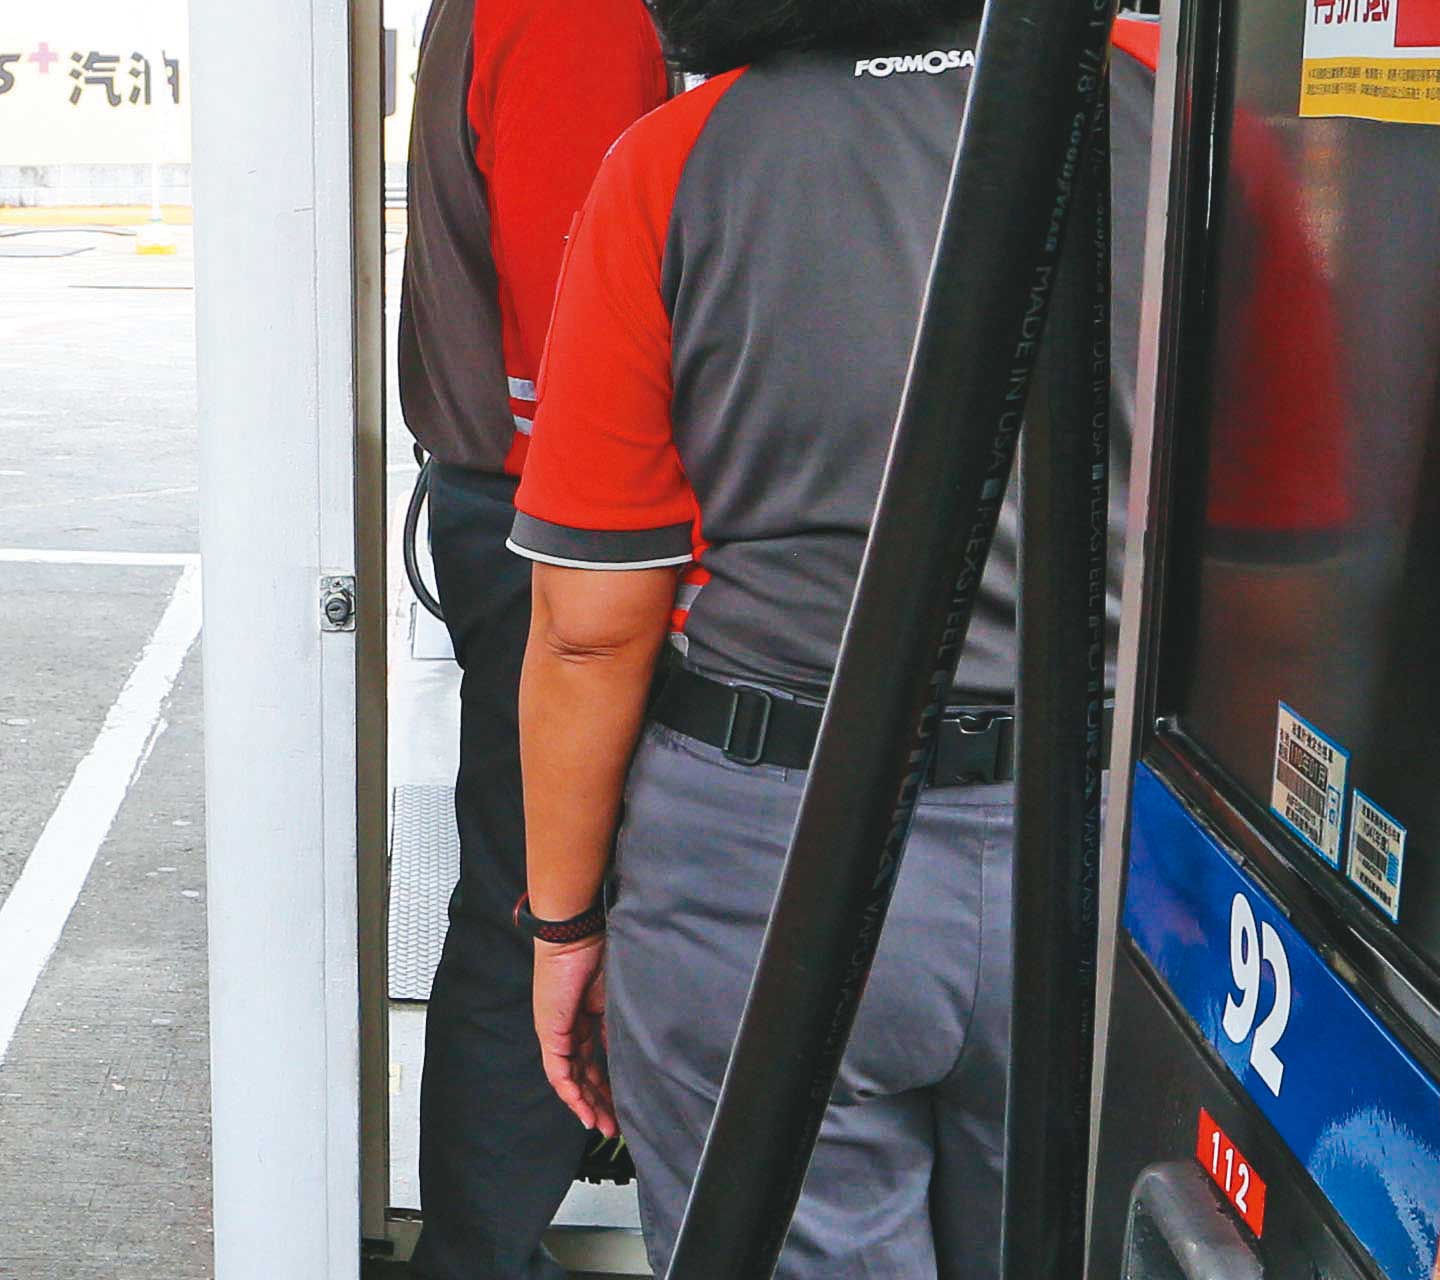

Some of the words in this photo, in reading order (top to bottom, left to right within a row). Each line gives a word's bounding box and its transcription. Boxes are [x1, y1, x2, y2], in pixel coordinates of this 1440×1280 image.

[854, 50, 976, 78] FORMOSA
[1014, 263, 1052, 360] MADE
[1003, 367, 1035, 402] IN
[985, 410, 1018, 471] USA
[1222, 893, 1294, 1097] 92
[1208, 1125, 1252, 1216] 112
